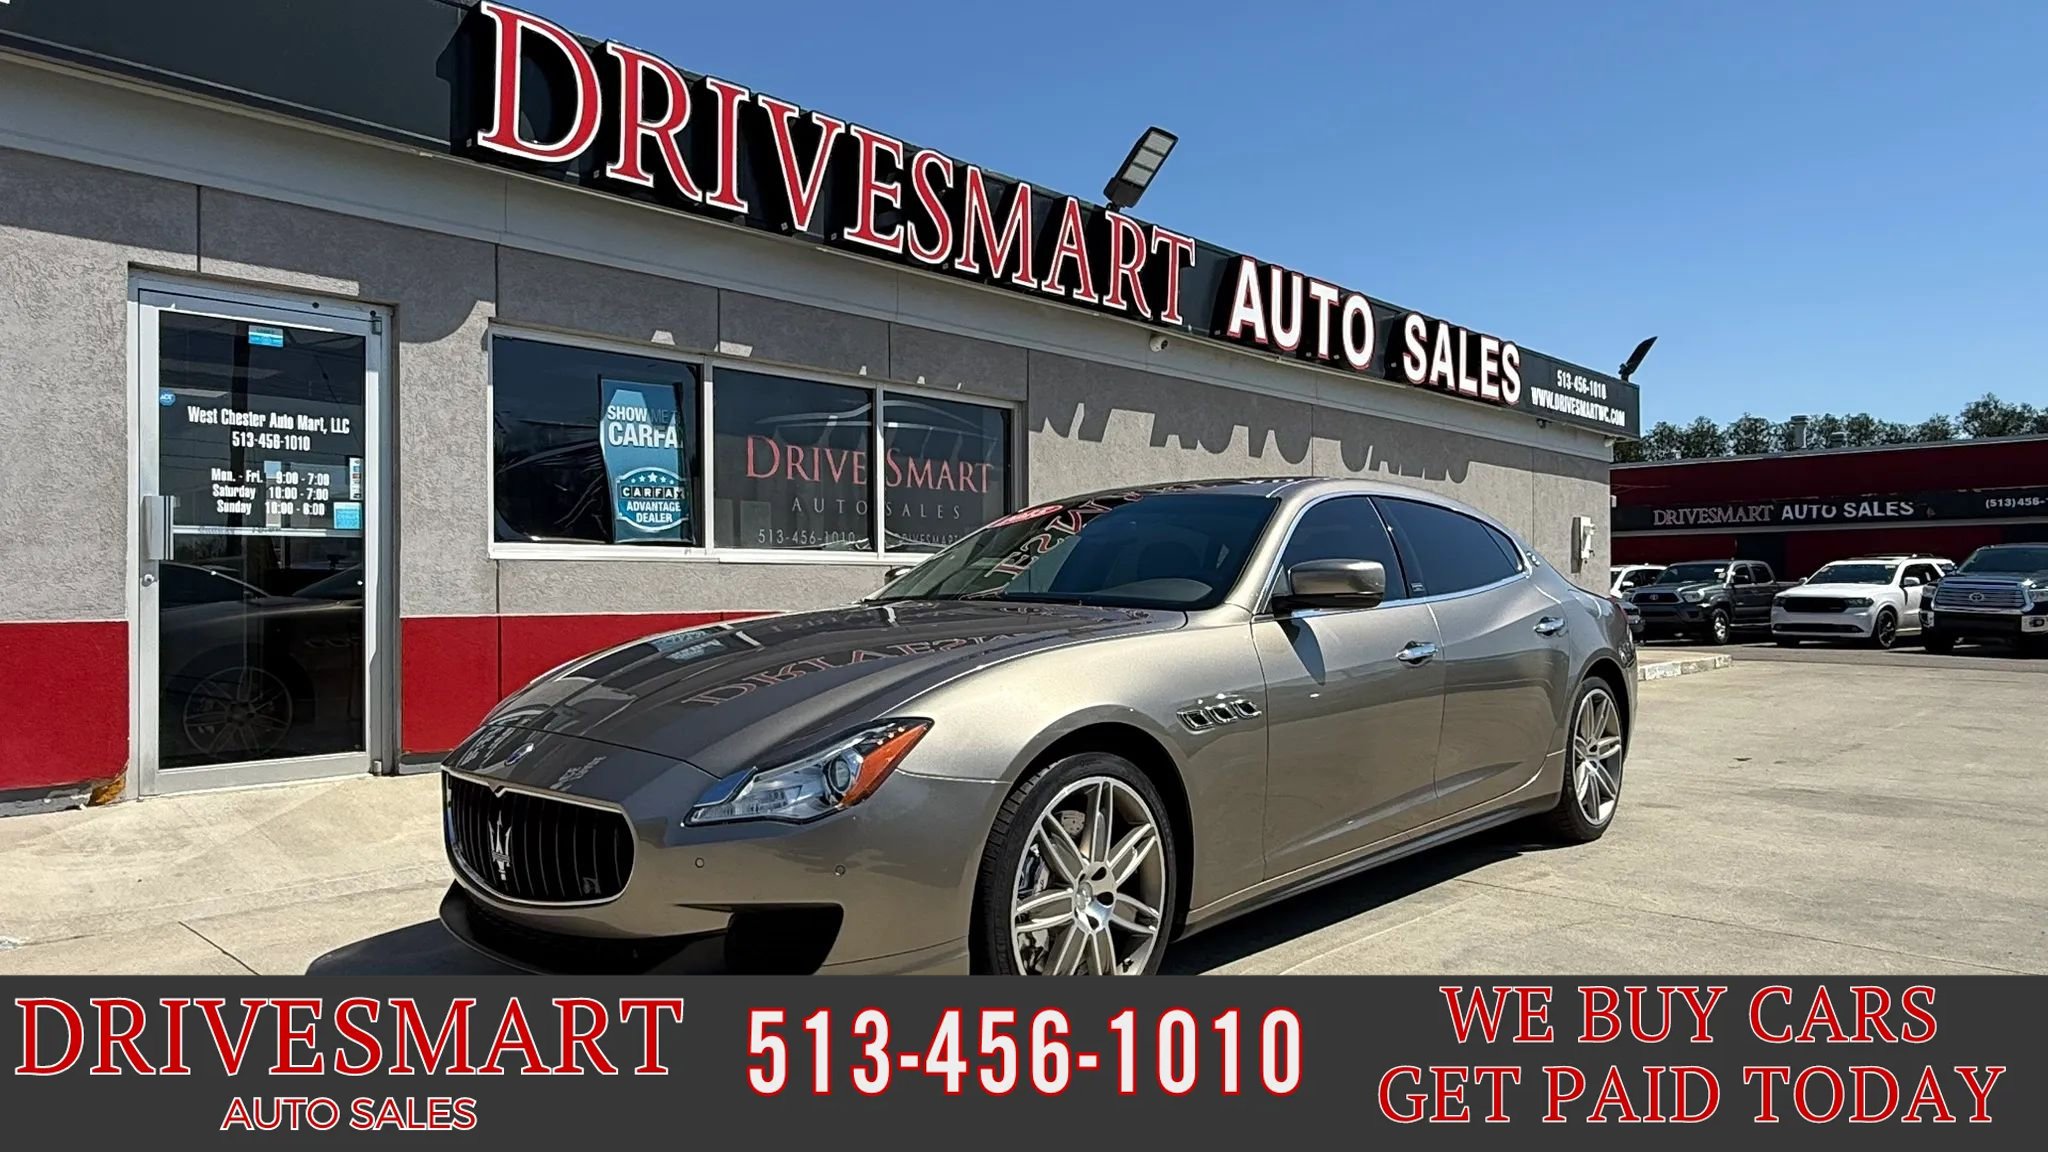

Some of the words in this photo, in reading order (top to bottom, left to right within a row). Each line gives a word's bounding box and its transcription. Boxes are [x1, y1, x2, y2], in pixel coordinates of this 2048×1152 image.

[478, 1, 1196, 326] DRIVESMART
[1227, 256, 1376, 370] AUTO
[1403, 313, 1521, 404] SALES
[1557, 370, 1607, 400] 513-456-1010
[607, 405, 648, 422] SHOW
[1531, 387, 1625, 427] WWW.DRIVESMARTWC.COM
[187, 406, 218, 424] West
[221, 408, 267, 428] Chester
[269, 412, 294, 430] Auto
[297, 414, 328, 434] Mart,
[331, 417, 350, 434] LLC
[232, 431, 310, 451] 513-456-1010
[746, 435, 867, 485] DRIVE
[886, 448, 994, 493] SMART
[211, 468, 236, 482] Mon.
[246, 470, 263, 483] Fri.
[276, 472, 299, 485] 9:00
[307, 473, 330, 486] 7:00
[212, 484, 256, 500] Saturday
[268, 487, 298, 500] 10:00
[306, 488, 329, 501] 7:00
[622, 486, 684, 499] CARFAX
[217, 500, 252, 515] Sunday
[265, 502, 293, 515] 10:00
[303, 503, 325, 515] 6:00
[626, 500, 681, 512] ADVANTAGE
[792, 497, 868, 515] AUTO
[886, 500, 960, 519] SALES
[1653, 505, 1774, 525] DRIVESMART
[1781, 504, 1837, 520] AUTO
[1843, 501, 1914, 518] SALES
[635, 512, 673, 523] DEALER
